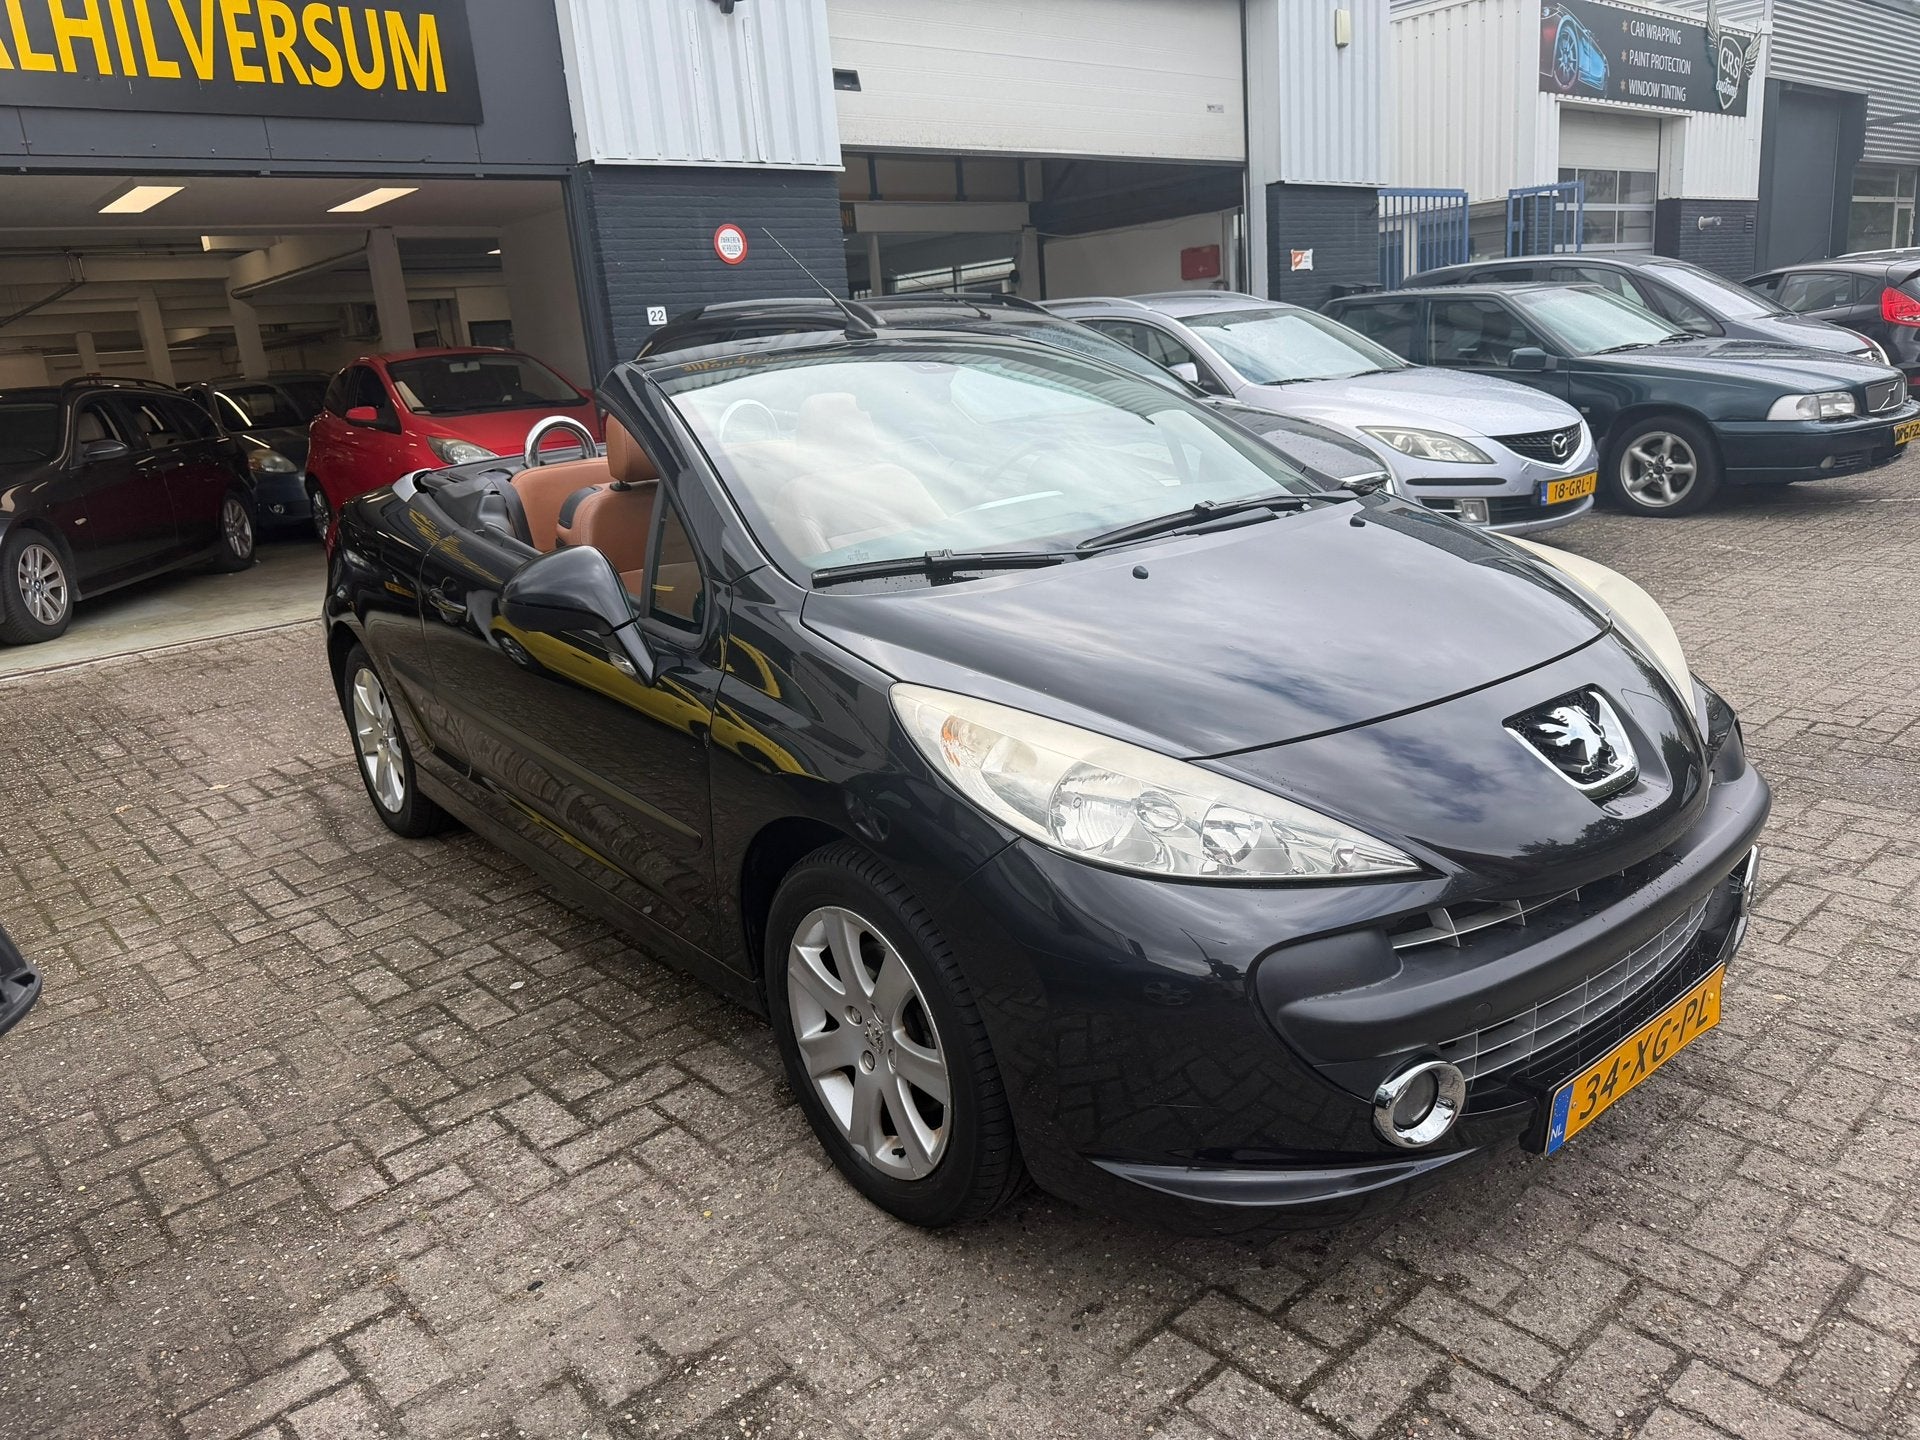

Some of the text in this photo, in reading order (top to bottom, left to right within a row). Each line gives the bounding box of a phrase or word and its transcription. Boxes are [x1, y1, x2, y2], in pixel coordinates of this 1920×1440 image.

[1630, 20, 1681, 45] CAR WRAPPING
[0, 0, 447, 93] LHILVERSUM
[1629, 49, 1691, 75] PAINT PROTECTION
[1720, 47, 1740, 79] CRS
[1628, 79, 1686, 101] WINDOW TINTING
[650, 310, 664, 321] 22
[1554, 476, 1592, 500] 18-GRL-1
[1579, 989, 1708, 1120] 34-XG-PL
[1550, 1123, 1563, 1142] NL
